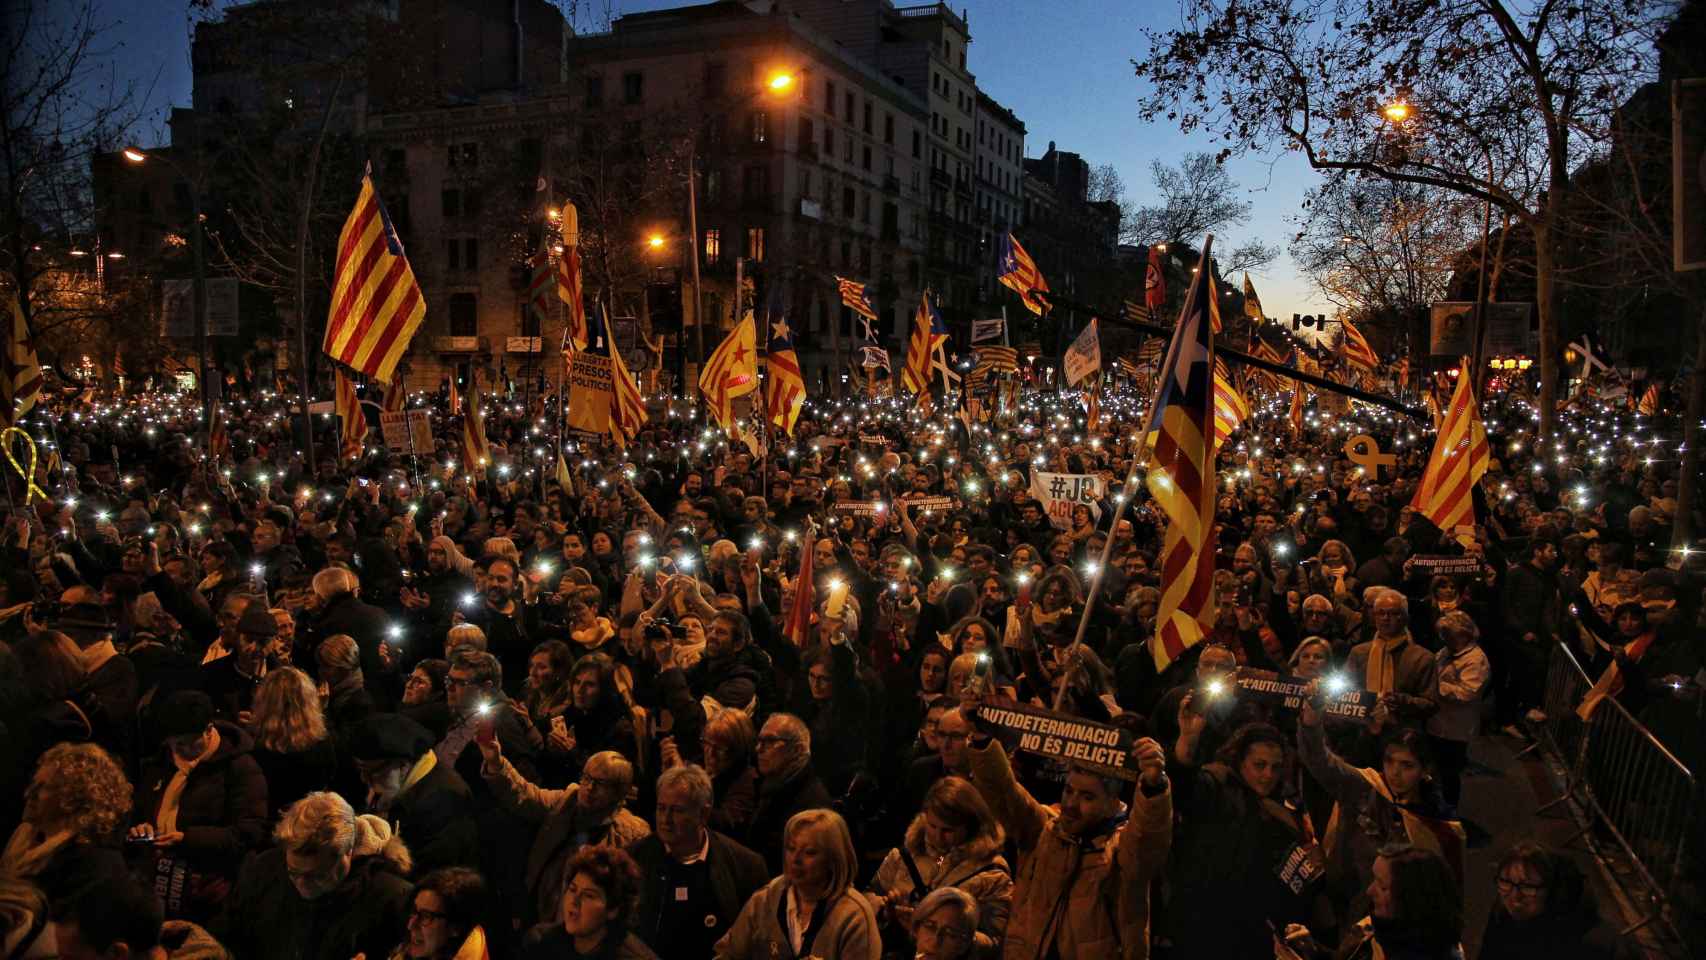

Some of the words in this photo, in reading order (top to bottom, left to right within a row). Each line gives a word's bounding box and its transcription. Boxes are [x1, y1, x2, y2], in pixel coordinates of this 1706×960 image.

[573, 363, 612, 381] PRESOS
[382, 412, 426, 424] LLIBETAT
[1284, 695, 1301, 709] NO
[1326, 703, 1367, 718] ELICTE
[1019, 732, 1041, 751] NO
[1042, 736, 1063, 754] ÉS
[1064, 741, 1127, 767] DELICTE
